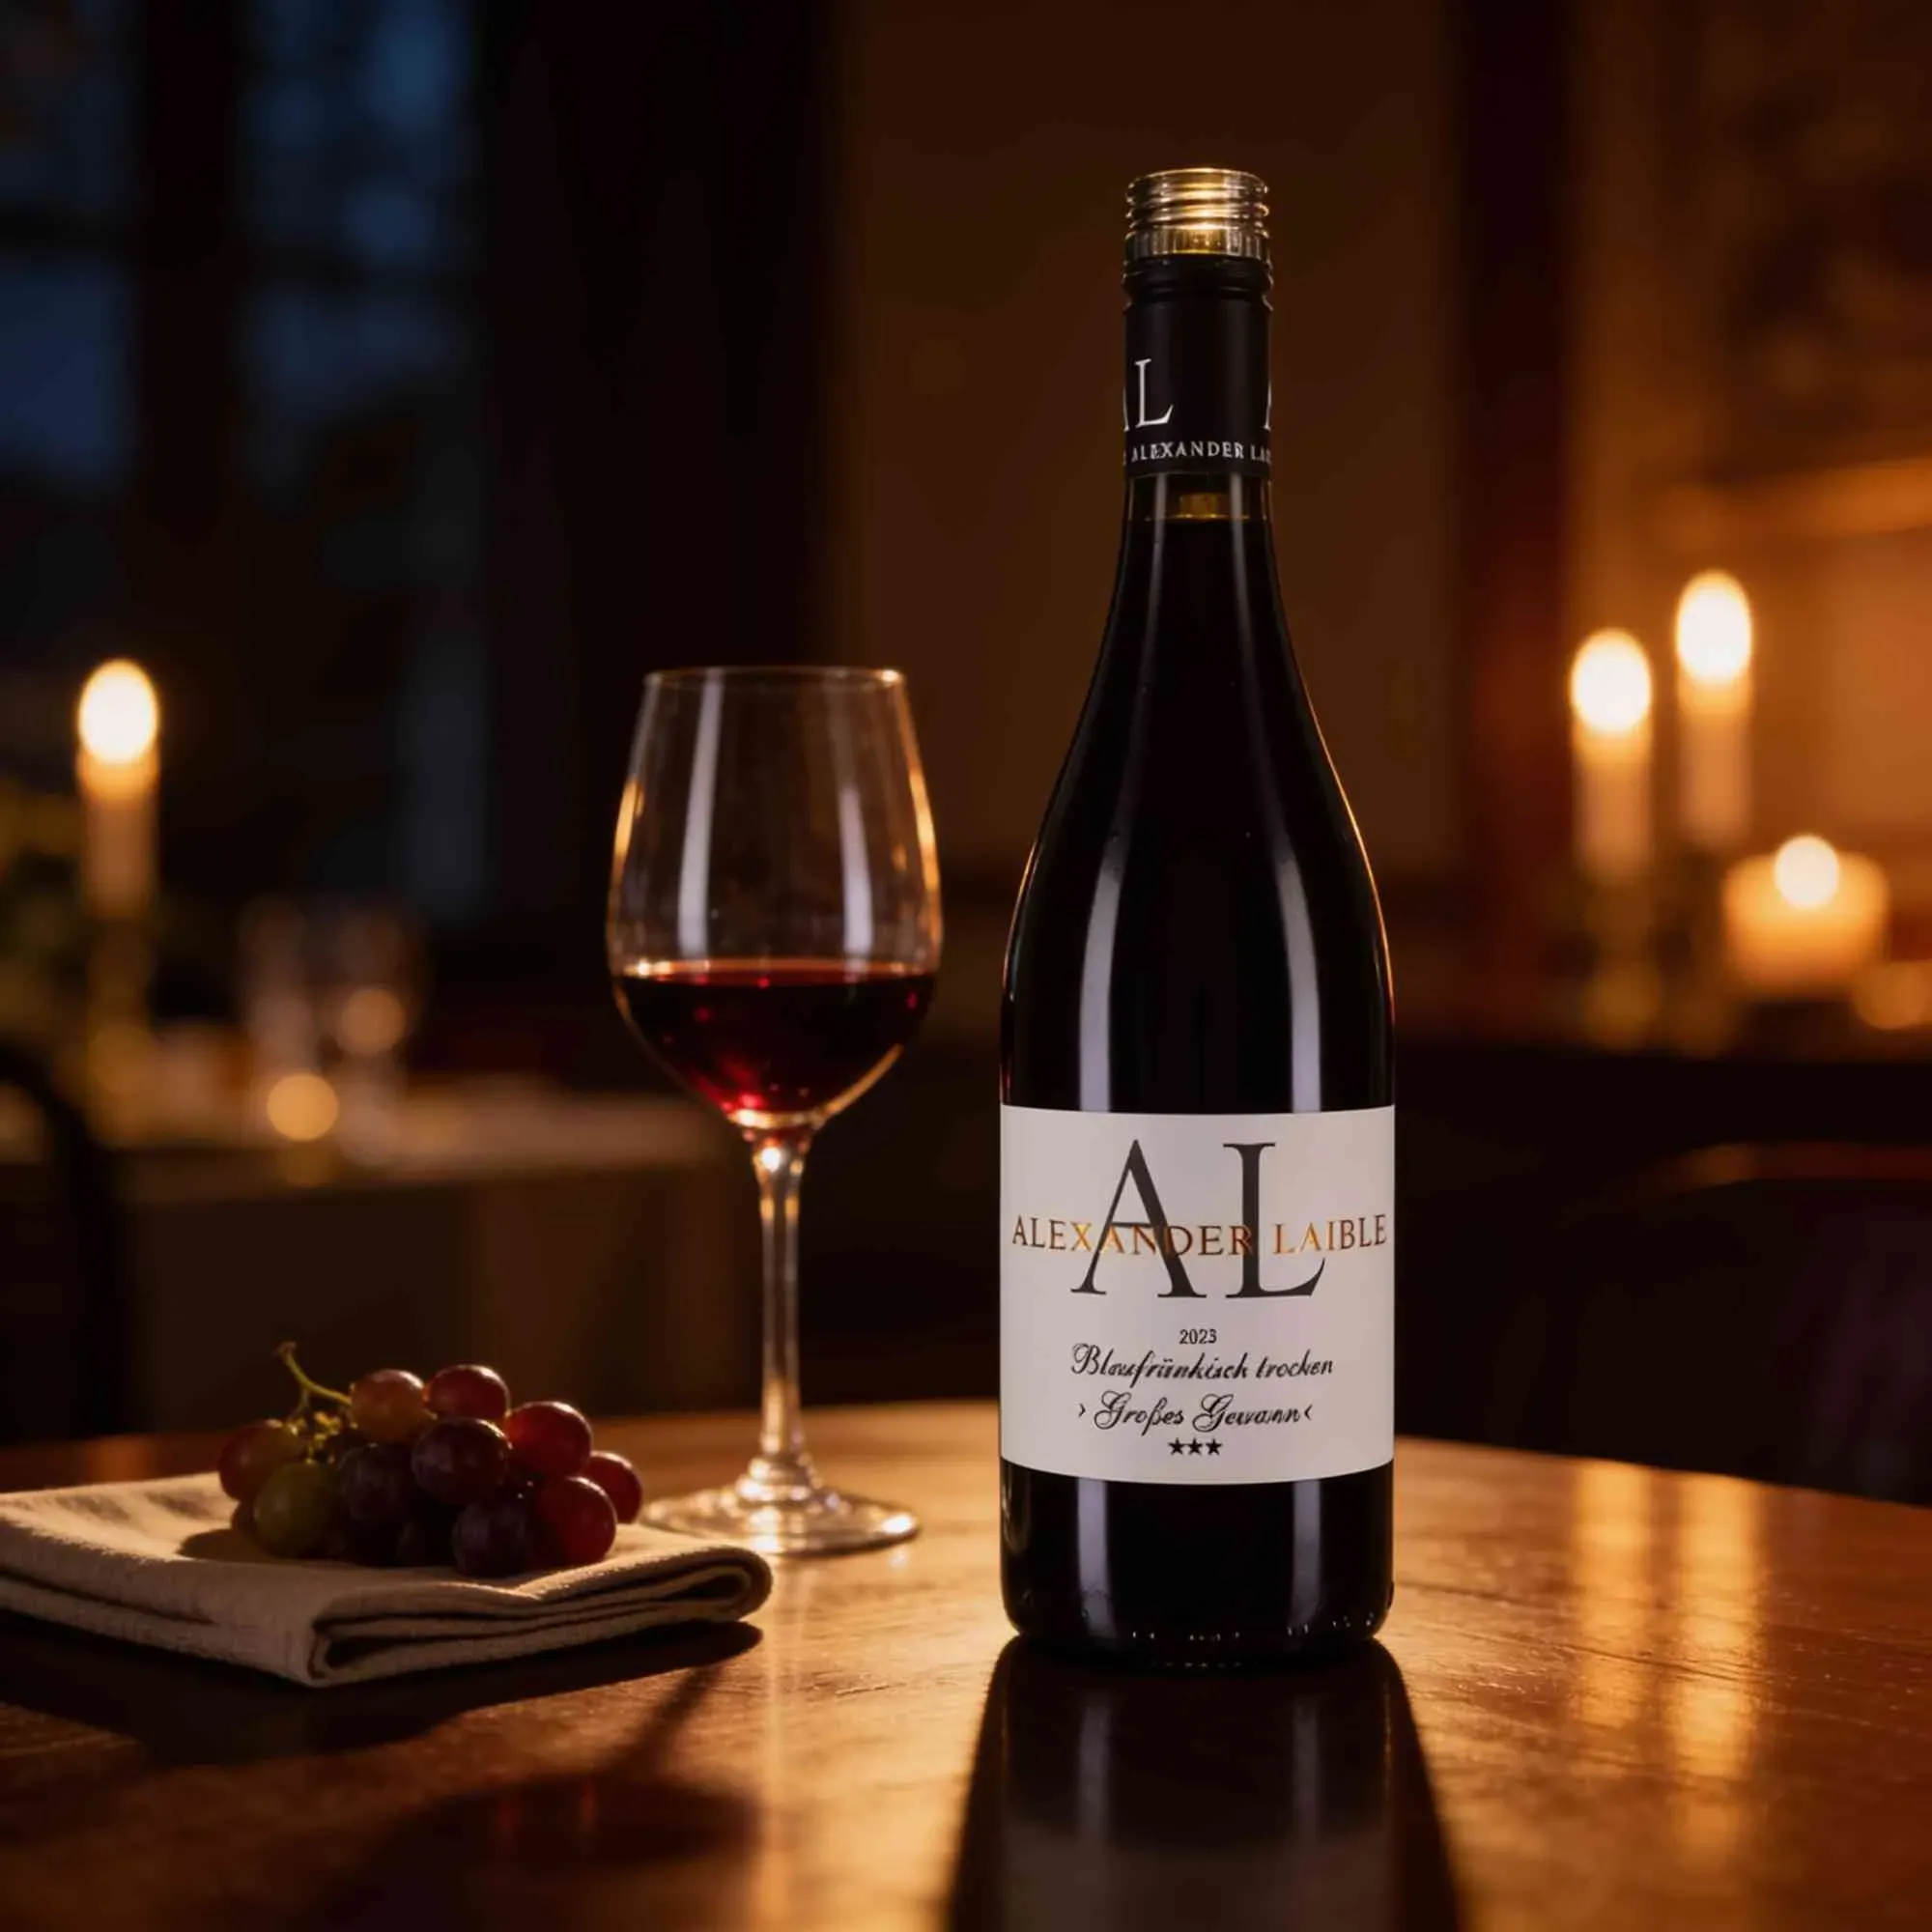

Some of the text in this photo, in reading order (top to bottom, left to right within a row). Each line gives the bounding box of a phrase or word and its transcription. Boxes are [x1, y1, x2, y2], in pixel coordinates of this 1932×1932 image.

[1131, 440, 1245, 463] ALEXANDER
[1011, 1214, 1388, 1257] ALEXANDER LAIBLE
[1070, 1139, 1326, 1298] AL
[1179, 1328, 1218, 1346] 2023
[1255, 1349, 1334, 1379] trocken
[1094, 1389, 1184, 1436] Großes
